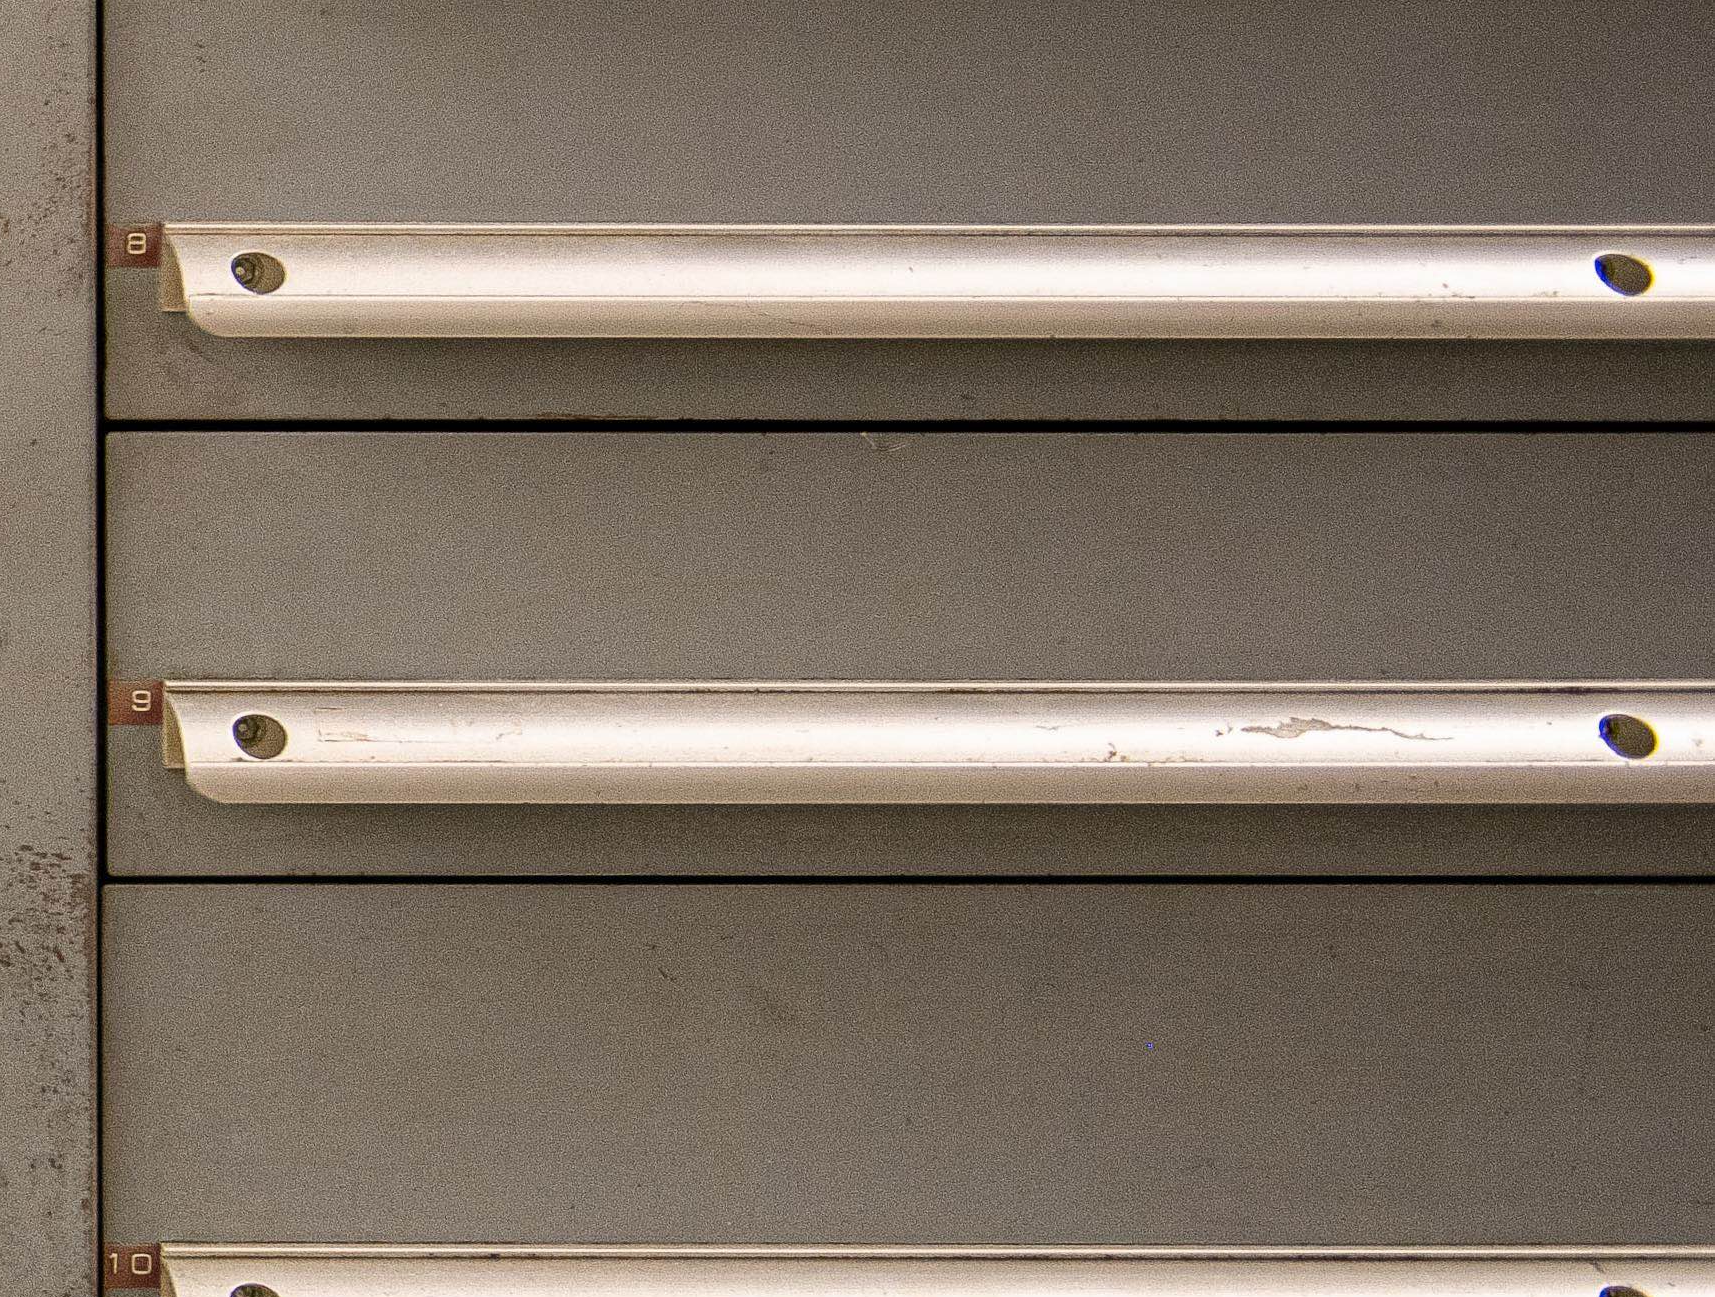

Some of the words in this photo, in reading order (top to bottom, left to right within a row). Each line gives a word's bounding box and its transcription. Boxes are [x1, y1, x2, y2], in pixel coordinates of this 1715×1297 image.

[126, 232, 147, 255] 8
[131, 689, 153, 713] 9
[109, 1252, 152, 1275] 10
